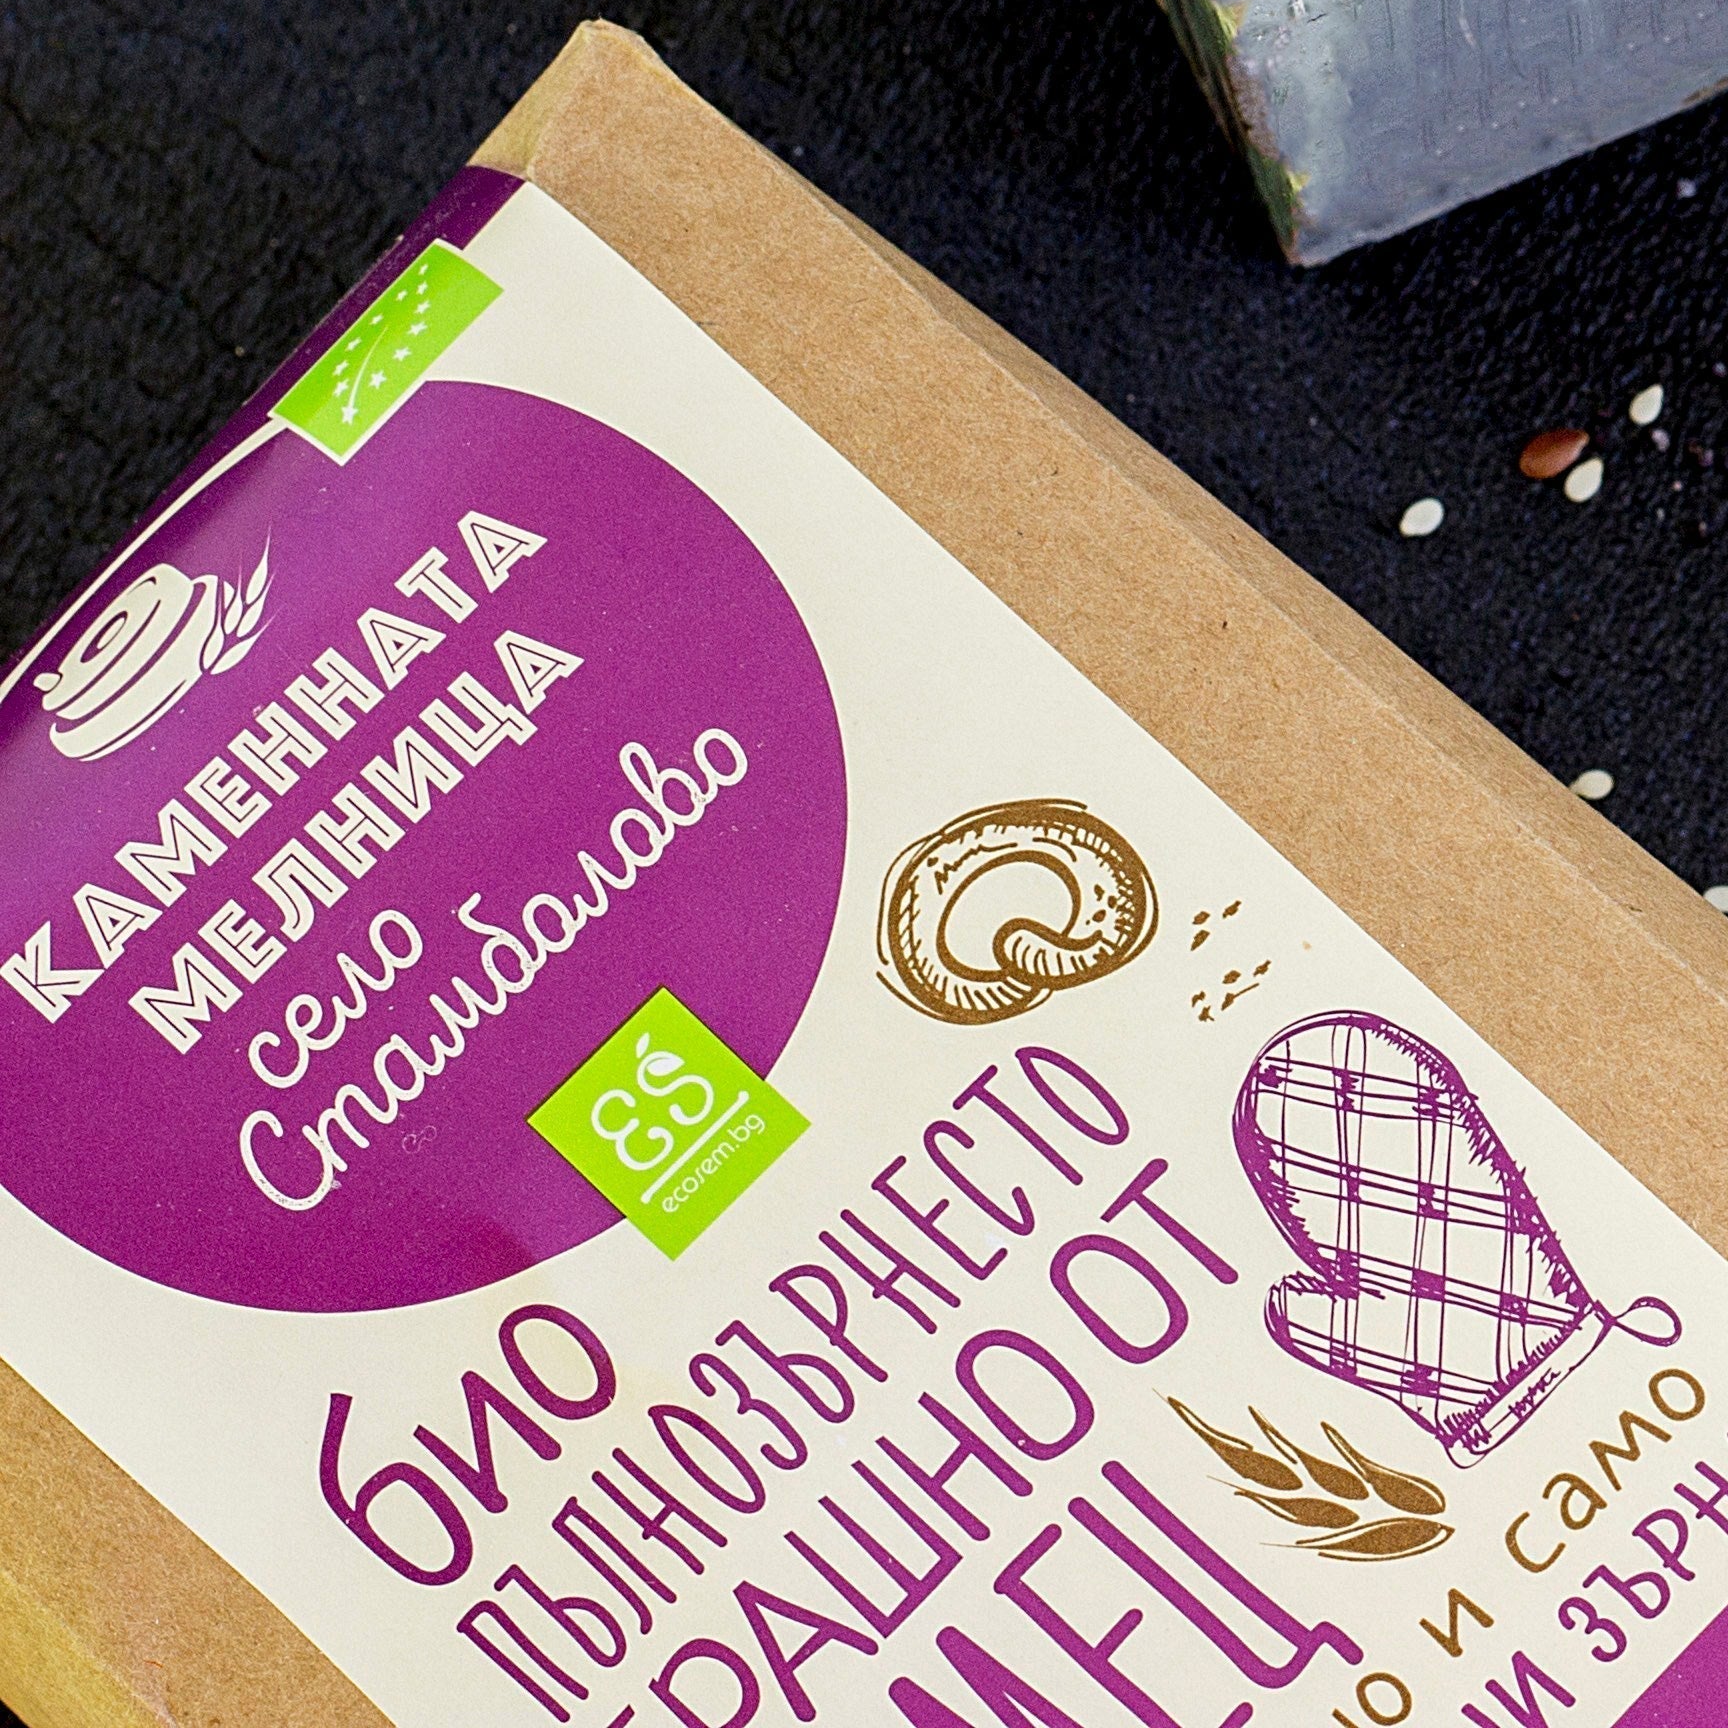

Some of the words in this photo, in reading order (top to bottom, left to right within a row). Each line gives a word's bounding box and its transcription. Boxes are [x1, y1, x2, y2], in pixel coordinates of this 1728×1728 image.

[1, 510, 548, 1024] КАМЕННАТА
[128, 629, 585, 1055] МЕЛНИЦА
[239, 727, 748, 1211] Стамболово
[247, 909, 424, 1089] село
[661, 1113, 766, 1213] ecosem.bg
[457, 1045, 1130, 1723] ПЪЛНОЗЪРНЕСТО
[606, 1328, 1095, 1728] РАШНО
[1048, 1156, 1240, 1364] ОТ
[1460, 1649, 1577, 1728] И
